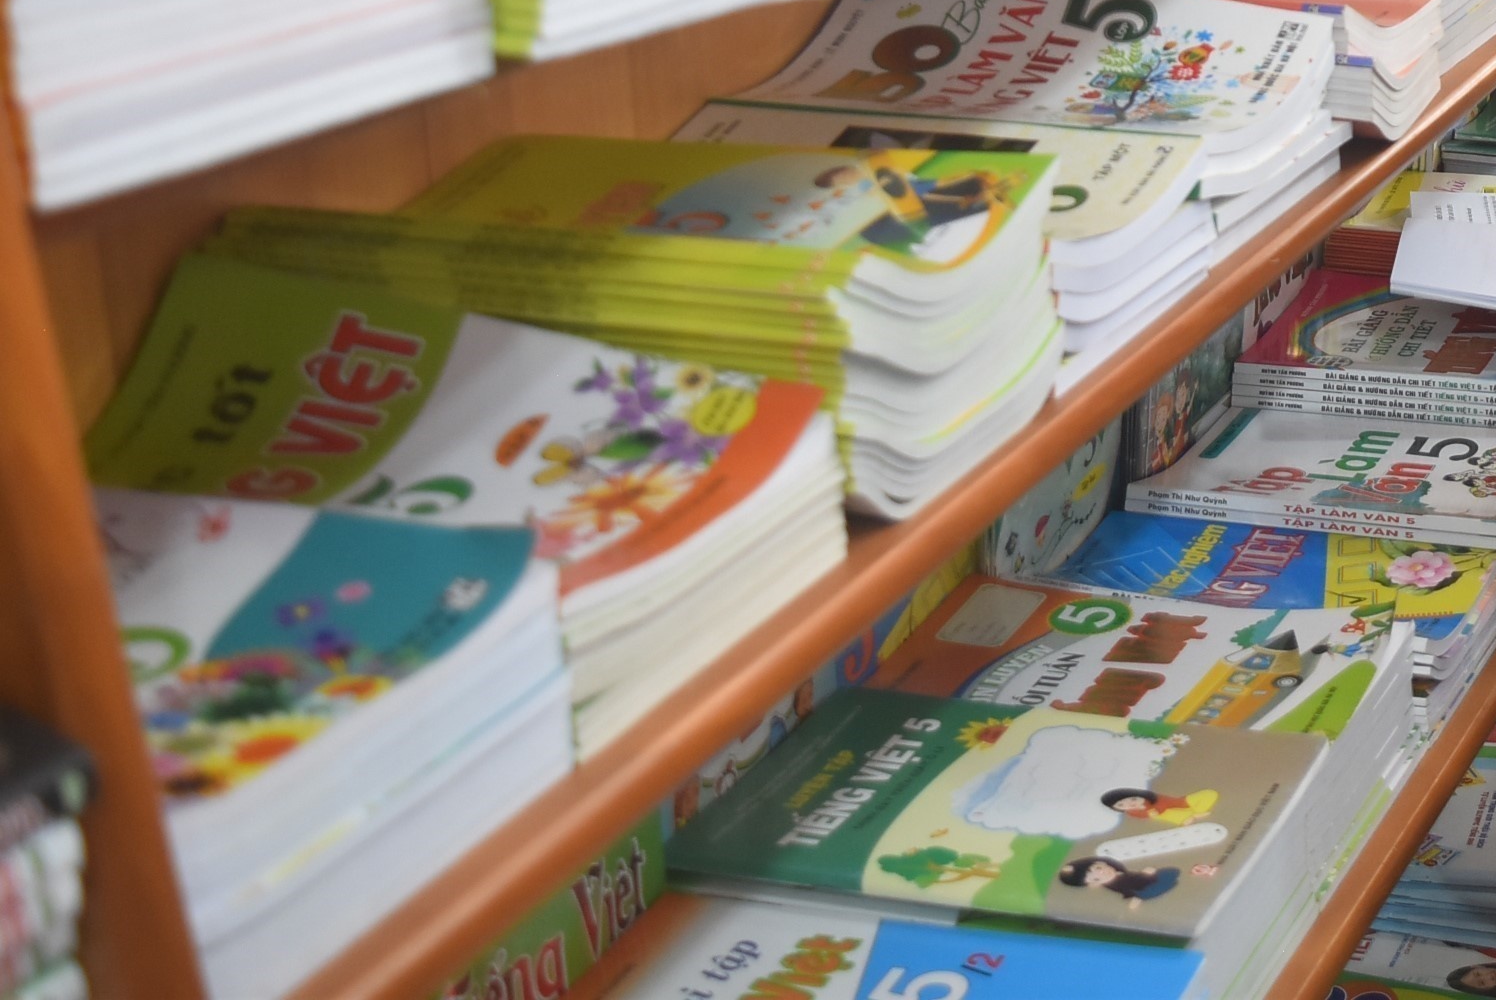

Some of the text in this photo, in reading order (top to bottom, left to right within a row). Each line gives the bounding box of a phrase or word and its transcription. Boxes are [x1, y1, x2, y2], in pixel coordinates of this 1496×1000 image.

[812, 24, 963, 101] 50
[1010, 30, 1082, 88] VIỆT
[1342, 308, 1389, 354] BÀI GIẢNG
[1371, 304, 1420, 357] HƯỚNG DẪN
[1397, 318, 1438, 358] CHI TIẾT
[268, 312, 428, 460] VIỆT
[1339, 372, 1358, 380] GIẢNG
[1368, 375, 1391, 384] HƯỚNG
[1393, 375, 1406, 384] DẪN
[1422, 377, 1436, 386] TIẾT
[1438, 379, 1456, 389] TIẾNG
[1458, 380, 1475, 390] VIỆT
[190, 362, 276, 448] tốt
[1334, 406, 1354, 414] GIẢNG
[1364, 408, 1386, 417] HƯỚNG
[1388, 409, 1402, 418] DẪN
[1417, 411, 1431, 421] TIẾT
[1433, 413, 1452, 422] TIẾNG
[1454, 414, 1470, 426] VIỆT
[1309, 430, 1401, 484] Làm
[1405, 435, 1479, 462] 5
[1148, 490, 1228, 507] Phạm Thị Như Quỳnh
[1209, 466, 1315, 497] Tập
[1333, 461, 1438, 503] Văn
[1147, 503, 1227, 519] Phạm Thị Như Quỳnh
[1283, 503, 1416, 526] TẬP LÀM VĂN 5
[1283, 517, 1414, 540] TẬP LÀM VĂN 5
[1181, 523, 1229, 572] nghiệm
[1221, 526, 1306, 579] VIỆT
[1058, 604, 1118, 629] 5
[991, 643, 1056, 684] LUYỆN
[776, 716, 942, 846] TIẾNG VIỆT 5
[571, 834, 651, 963] Việt
[702, 938, 760, 981] tập
[860, 966, 970, 1000] 5
